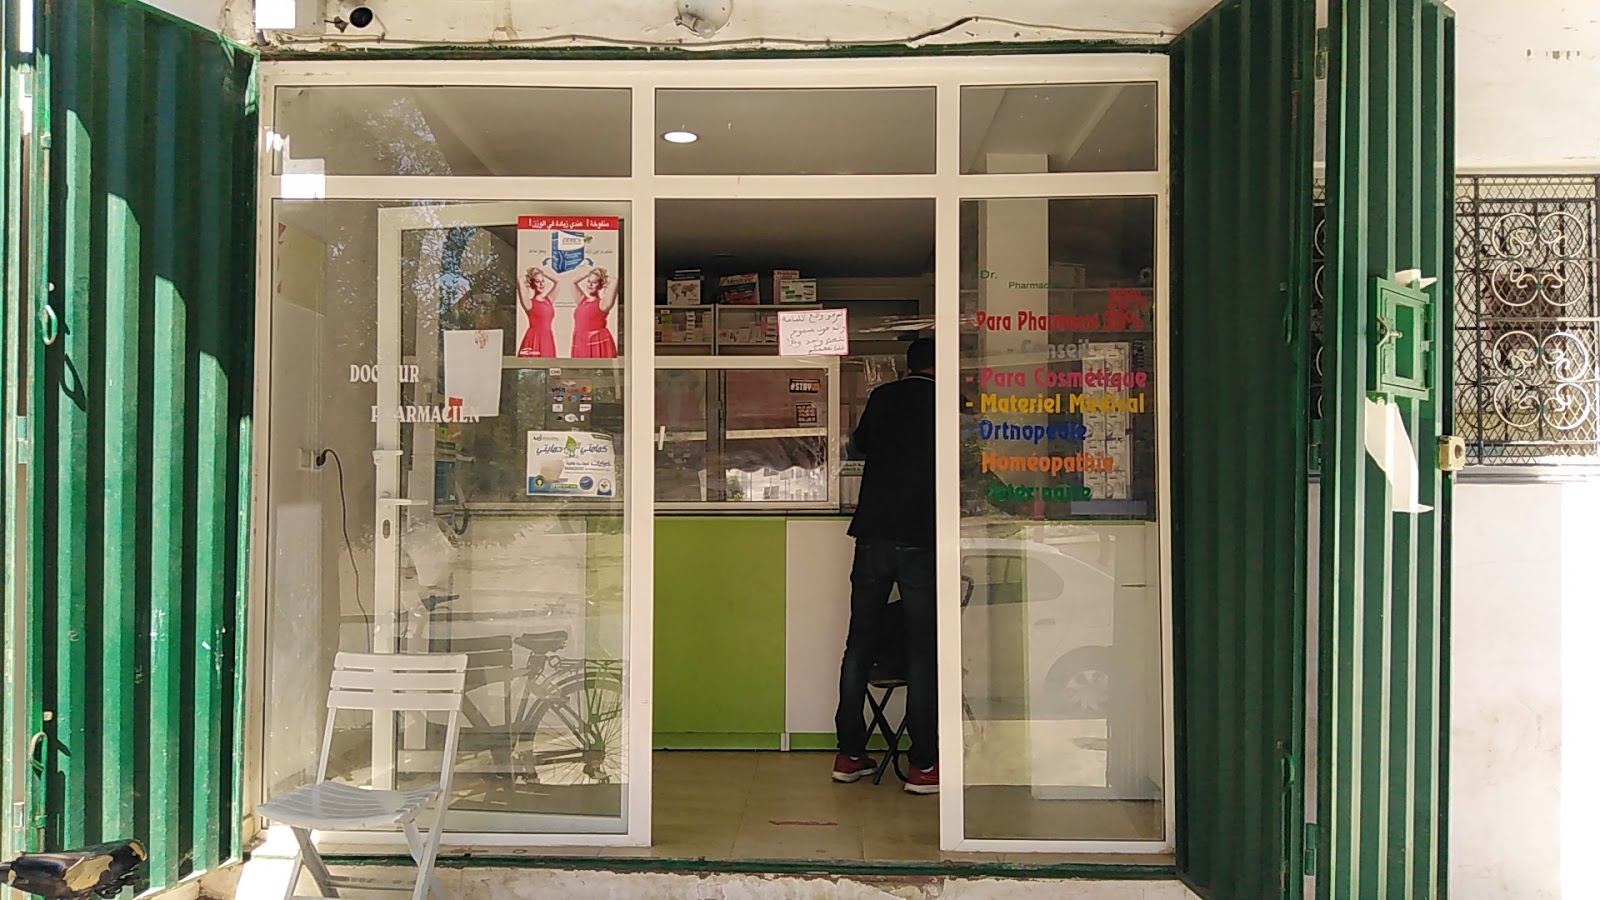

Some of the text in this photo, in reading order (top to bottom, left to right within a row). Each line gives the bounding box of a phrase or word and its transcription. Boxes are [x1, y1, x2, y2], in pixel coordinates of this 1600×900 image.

[980, 269, 998, 279] Dr.
[976, 310, 1011, 331] Para
[1017, 310, 1098, 331] Pharmacie
[980, 367, 1147, 392] Para Cosmétique
[980, 392, 1061, 413] Materiel
